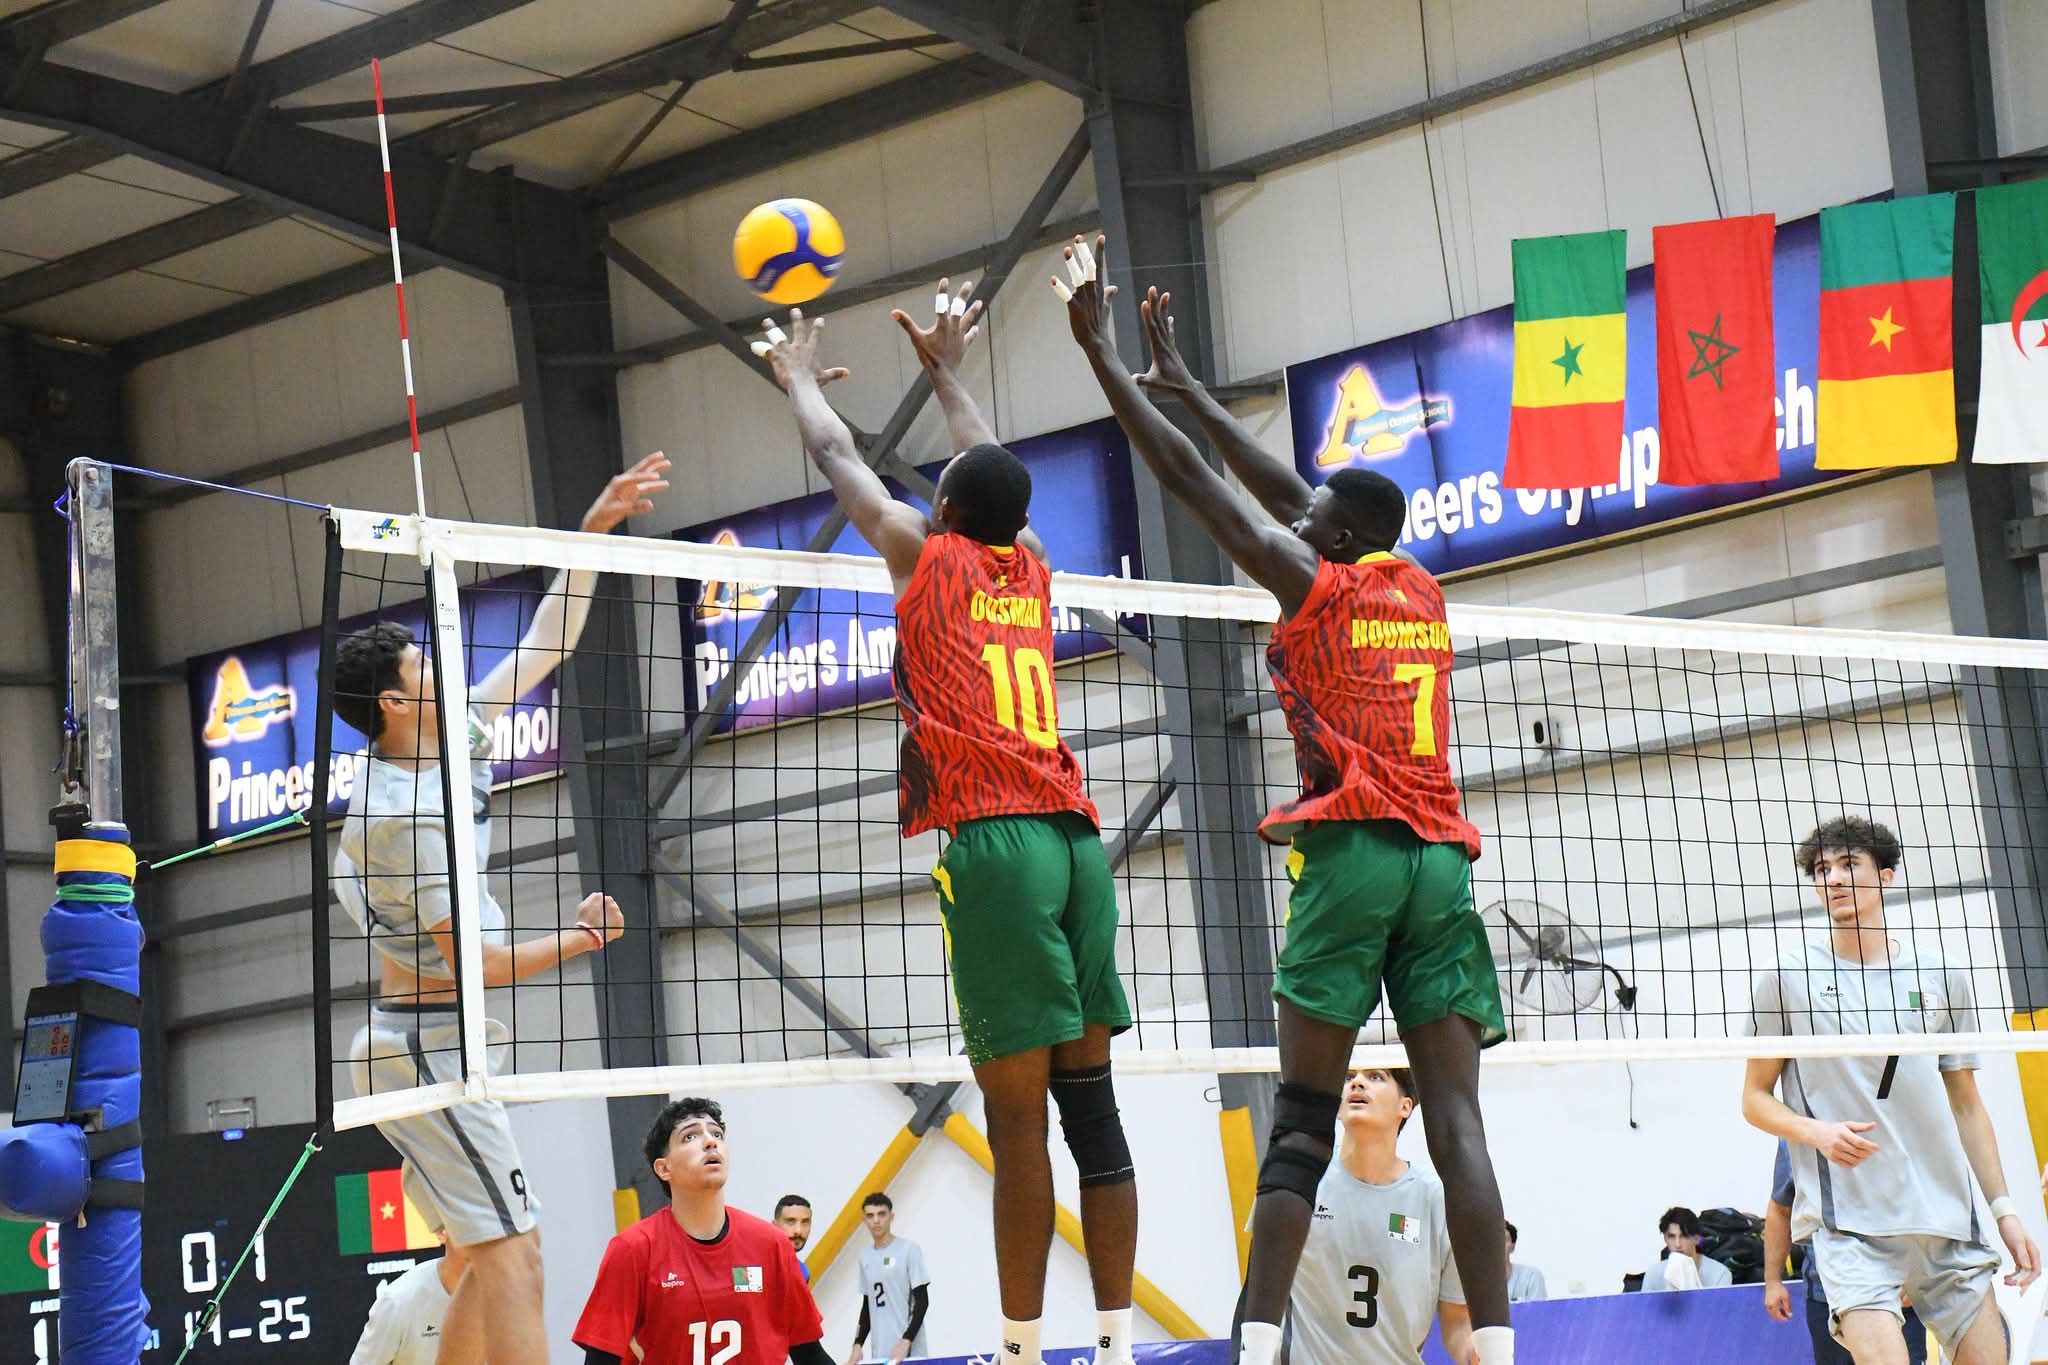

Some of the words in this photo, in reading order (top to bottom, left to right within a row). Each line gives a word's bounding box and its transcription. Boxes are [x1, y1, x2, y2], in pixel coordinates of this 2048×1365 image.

[971, 590, 1041, 629] OUSMAN
[982, 634, 1059, 749] 10
[1393, 663, 1437, 757] 7
[510, 1168, 528, 1211] 9
[181, 1231, 217, 1293] 0
[873, 1281, 886, 1307] 2
[1346, 1264, 1379, 1328] 3
[688, 1319, 742, 1365] 12
